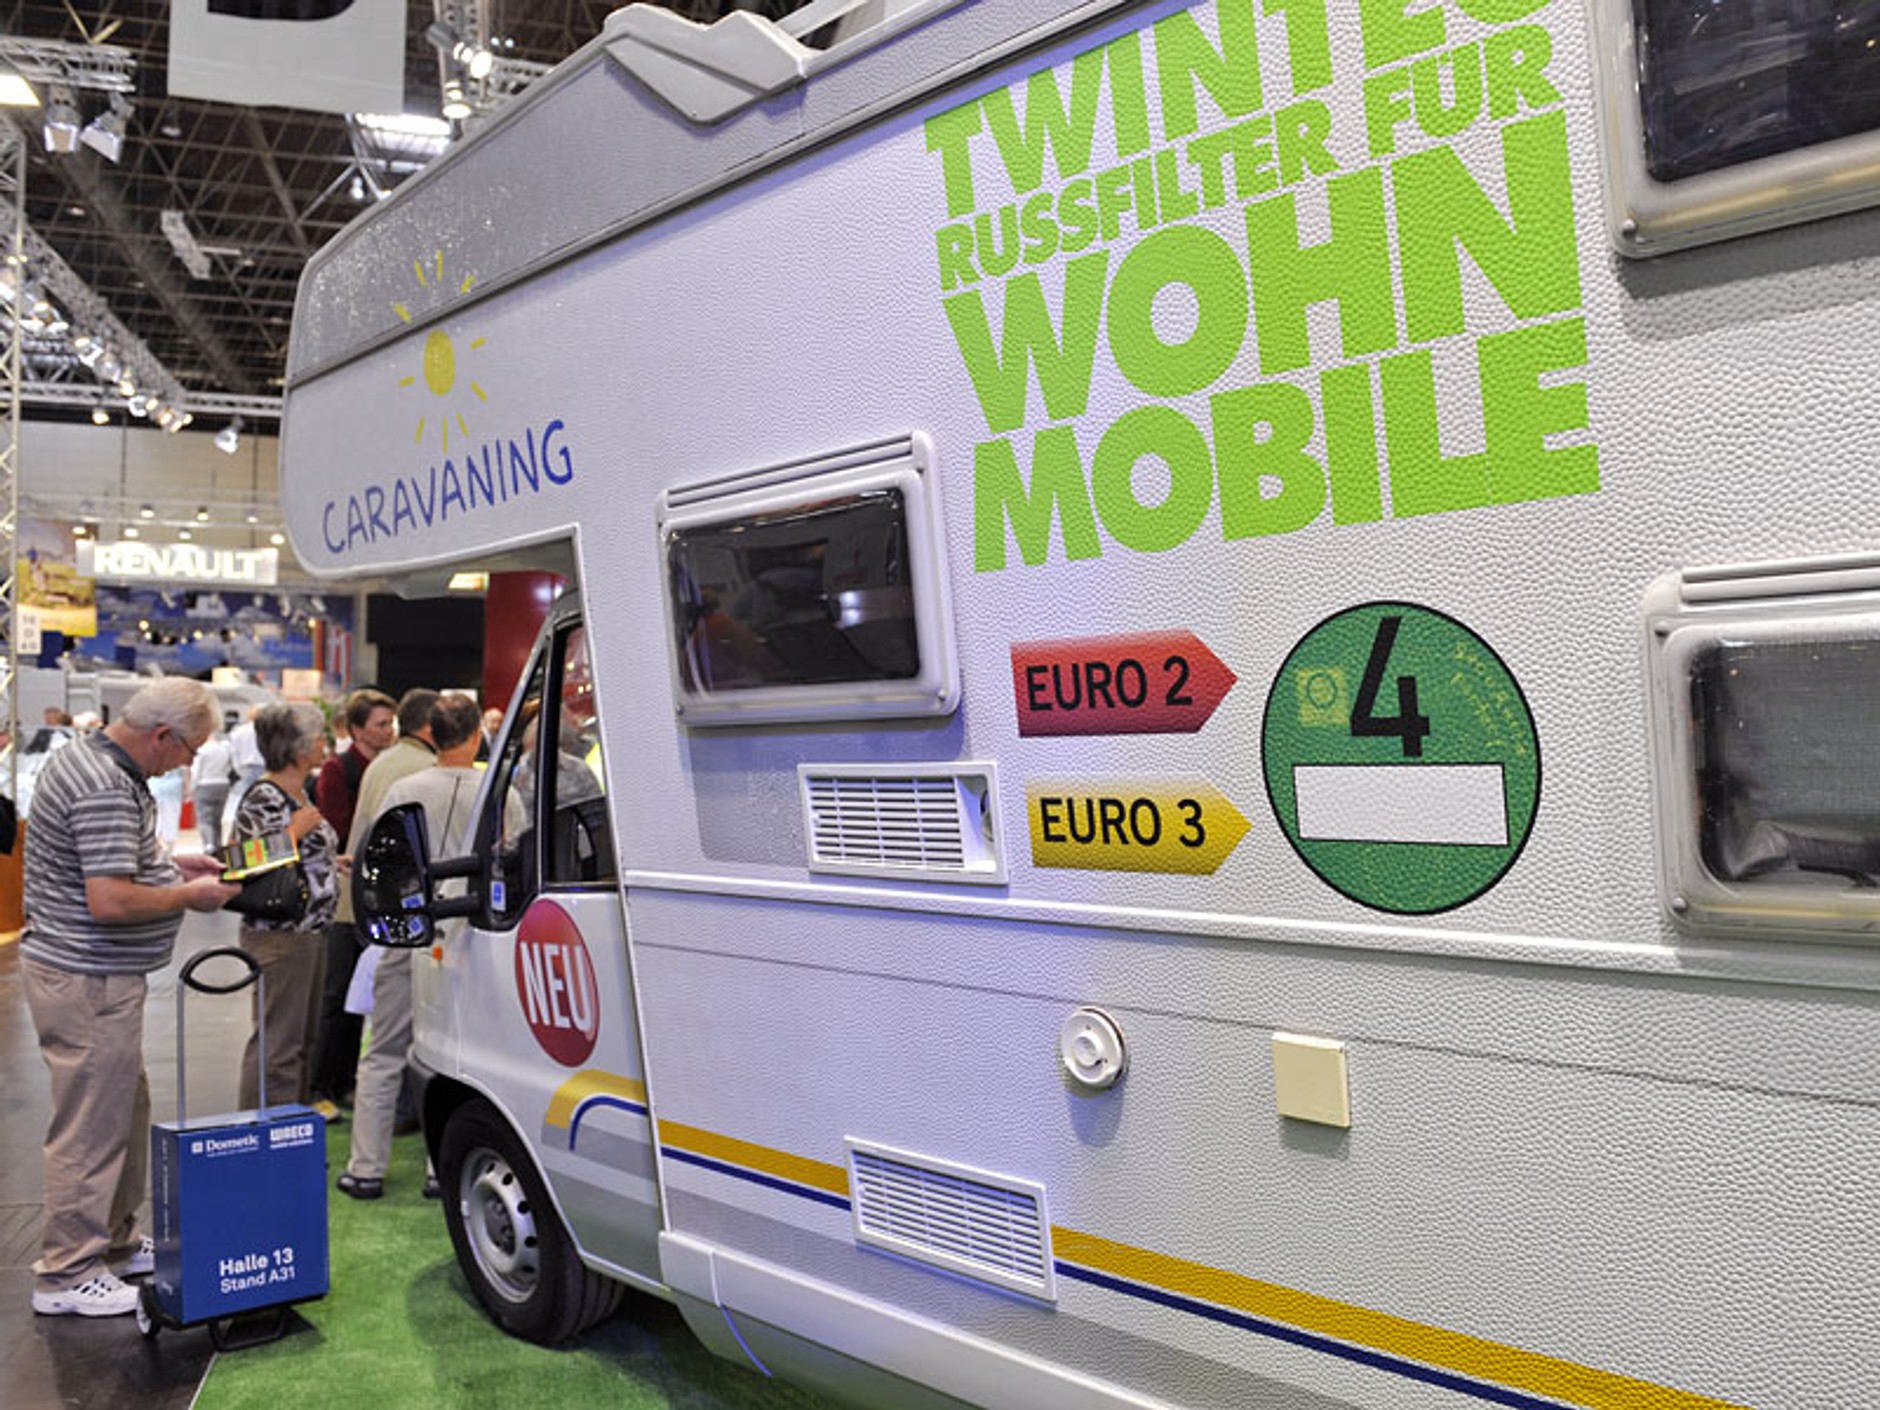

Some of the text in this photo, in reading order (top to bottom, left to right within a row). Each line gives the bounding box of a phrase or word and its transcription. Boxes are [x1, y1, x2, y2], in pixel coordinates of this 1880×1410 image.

[924, 0, 1552, 218] TWINT
[935, 100, 1340, 292] RUSSFILTER
[943, 108, 1583, 434] WOHN
[323, 419, 574, 554] CARAVANING
[973, 316, 1602, 575] MOBILE
[93, 544, 260, 579] RENAULT
[1026, 655, 1193, 712] EURO 2
[1351, 616, 1430, 757] 4
[1040, 796, 1206, 847] EURO 3
[519, 941, 593, 1033] NEU
[219, 1247, 294, 1278] Halle 13
[220, 1265, 296, 1294] Stand A31
